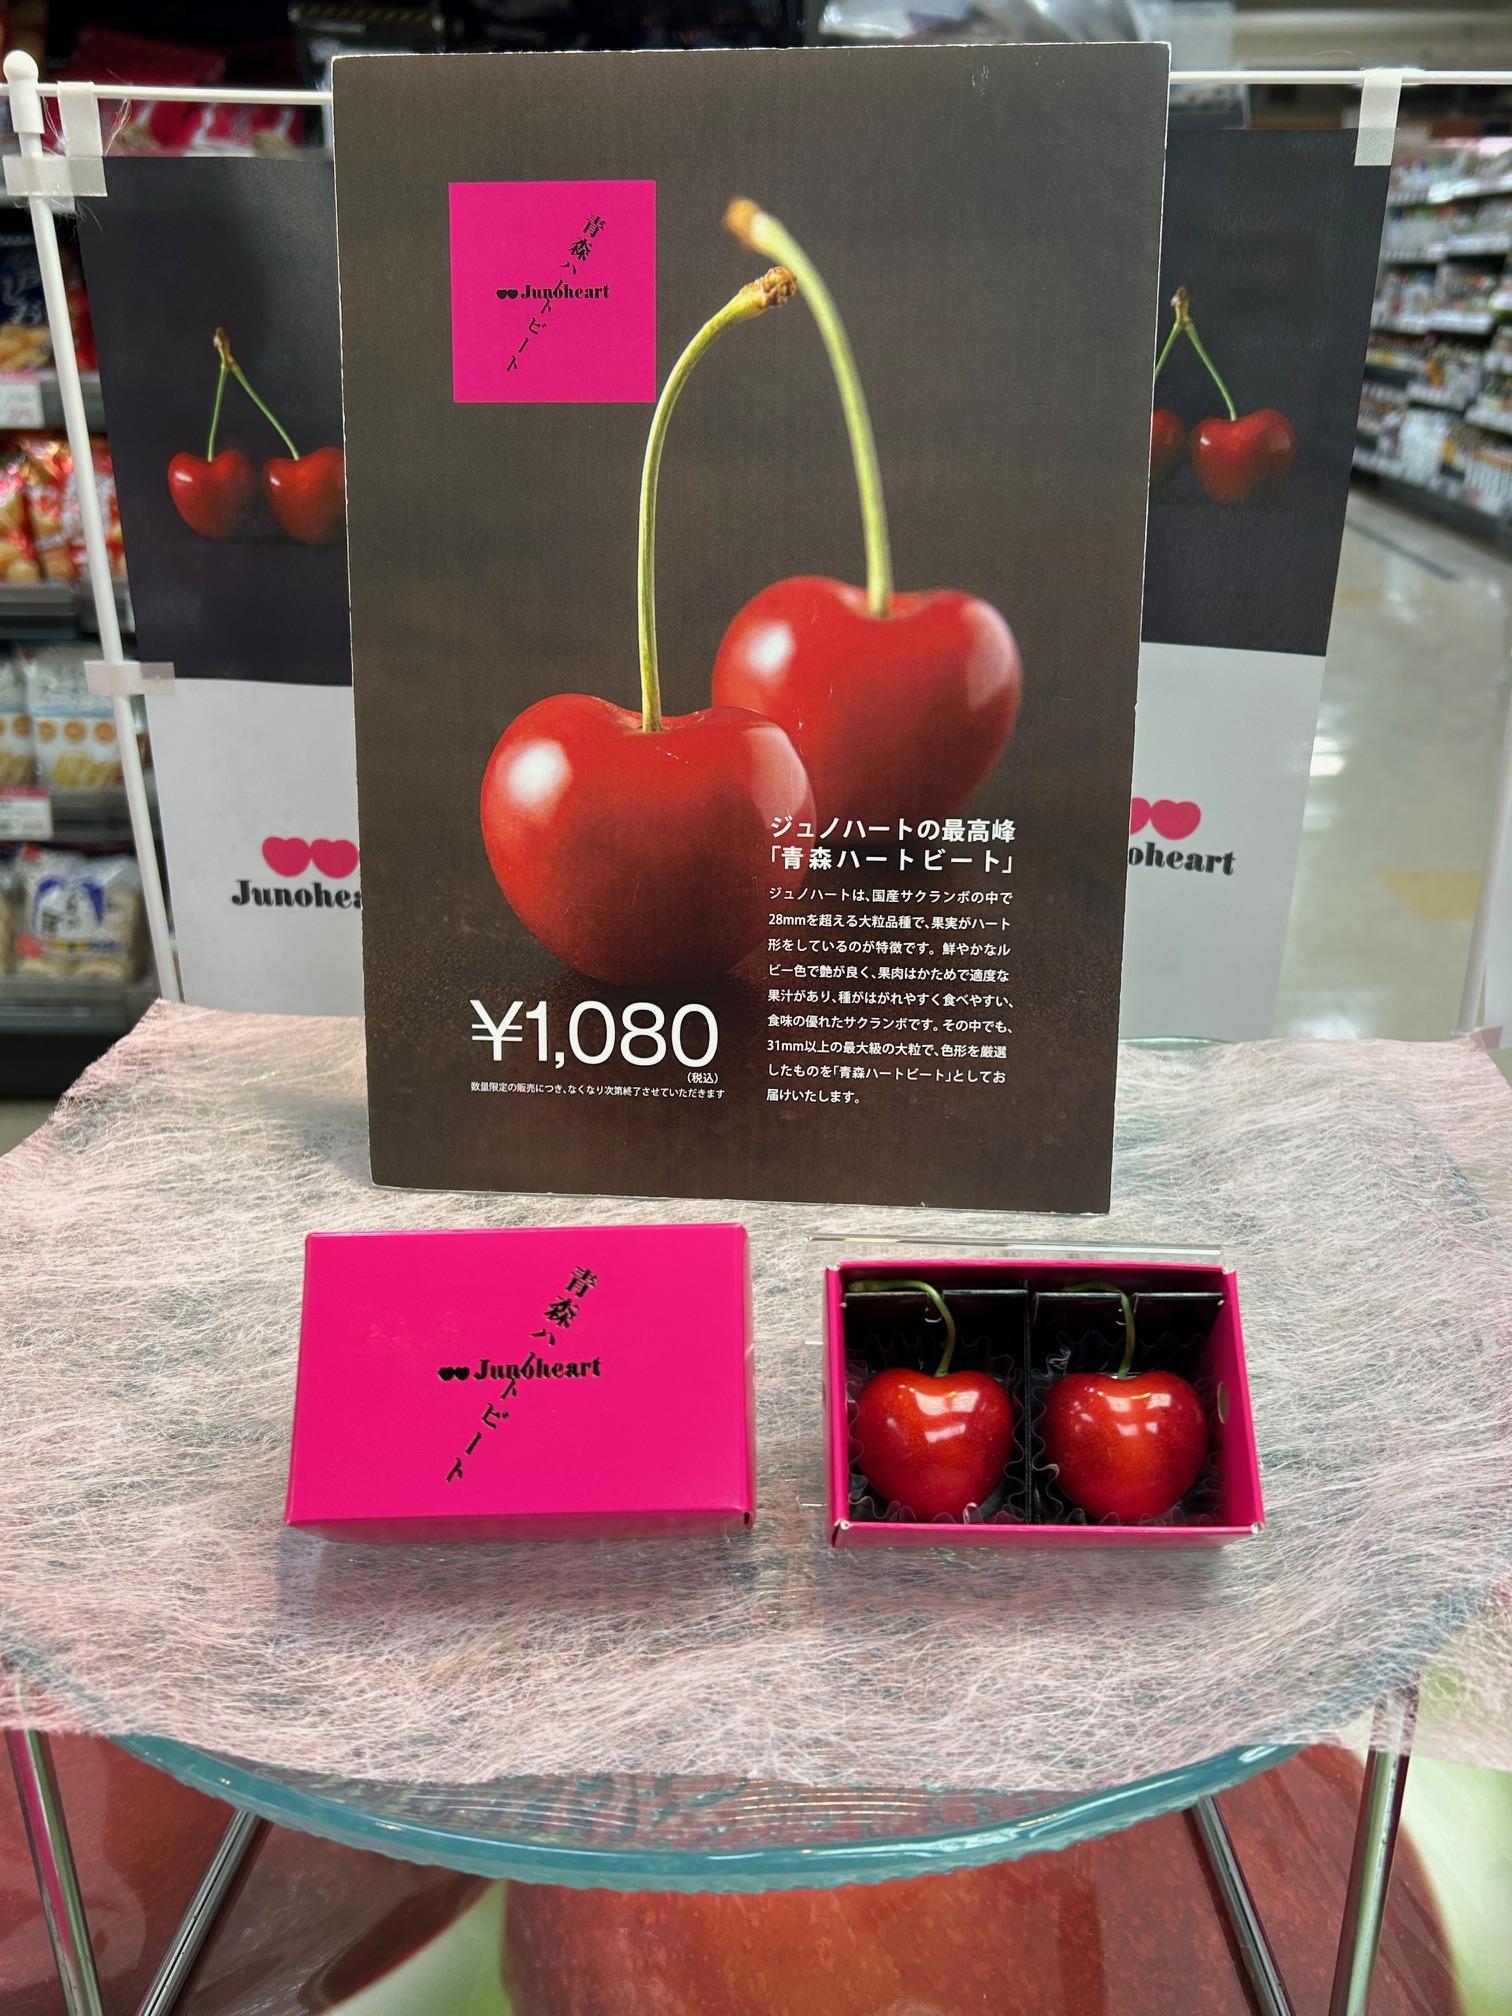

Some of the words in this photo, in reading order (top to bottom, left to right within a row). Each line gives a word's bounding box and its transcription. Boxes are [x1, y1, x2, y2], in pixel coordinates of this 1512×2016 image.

[521, 284, 610, 300] Junoheart
[769, 815, 1017, 844] ジュノハートの最高峰
[770, 846, 1014, 874] 「青森ハートビート」
[769, 886, 1014, 905] ジュノハートは、国産サクランボの中で
[768, 913, 1010, 931] 28mmを超える大粒品種で、果実がハート
[767, 938, 1011, 957] 形をしているのが特徴です。鮮やかなル
[769, 964, 1010, 983] ビー色で艶が良く、果肉はかためで適度な
[767, 989, 1014, 1009] 果汁があり、種がはがれやすく食べやすい、
[767, 1014, 1013, 1034] 食味の優れたサクランボです。その中でも、
[470, 1000, 719, 1069] ¥1,080
[766, 1039, 1007, 1059] 31mm以上の最大級の大粒で、色形を厳選
[768, 1064, 1006, 1084] したものを「青森ハートビート」としてお
[470, 1081, 725, 1099] 数量限定の販売につき、なくなり次第終了させていただきます
[766, 1088, 860, 1104] 届けいたします。
[473, 1356, 601, 1381] Junoheart
